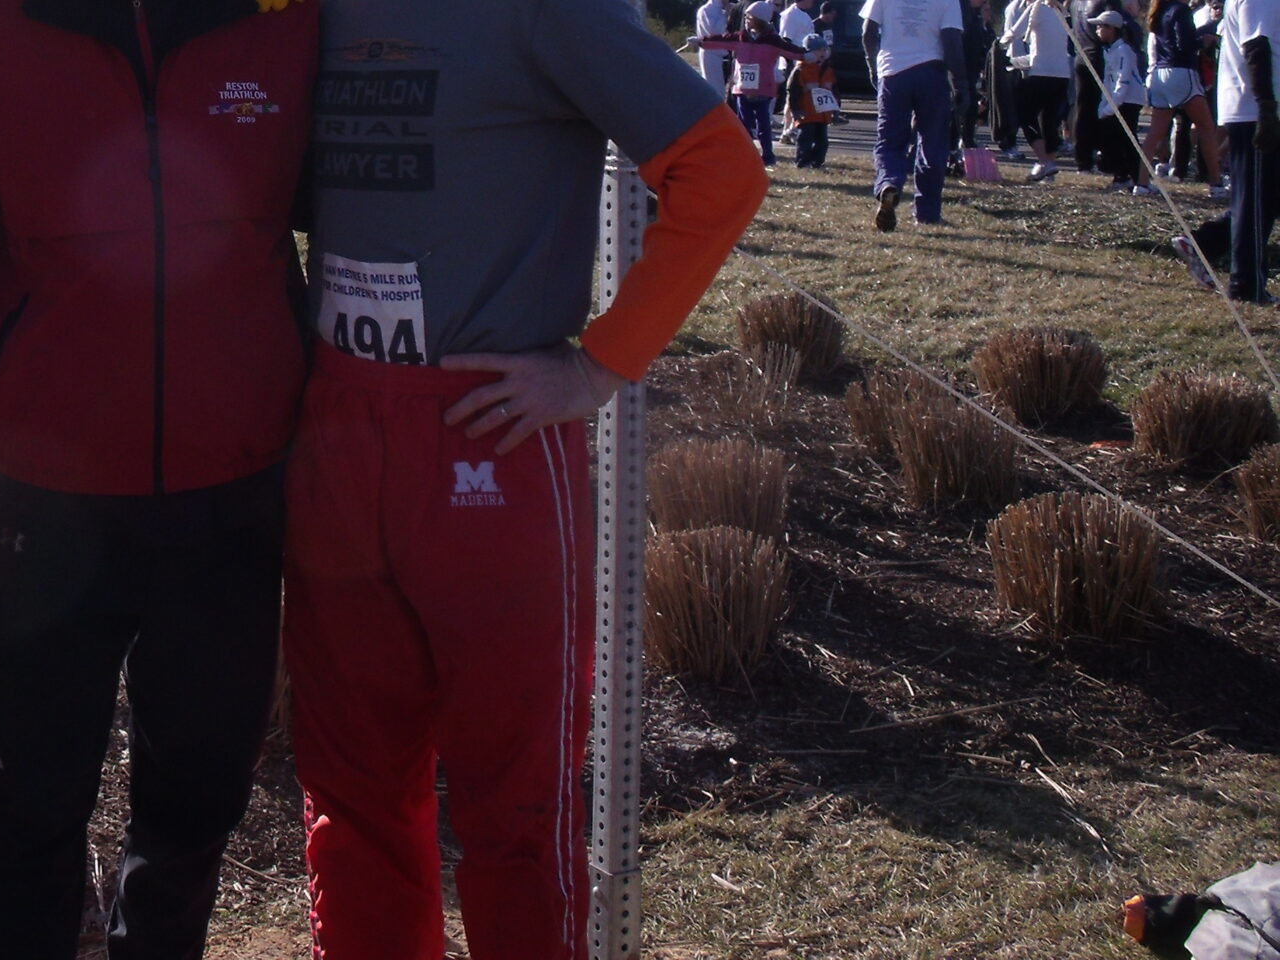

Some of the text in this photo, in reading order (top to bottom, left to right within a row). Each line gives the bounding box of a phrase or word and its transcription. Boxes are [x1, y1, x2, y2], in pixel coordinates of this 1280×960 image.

[219, 91, 268, 100] TRIATHLON
[225, 82, 259, 91] RESTON
[320, 79, 428, 105] RIATHLON
[816, 95, 834, 106] 971
[319, 120, 428, 137] RIAL
[316, 152, 418, 178] AWYER
[337, 268, 361, 283] METRE
[362, 274, 368, 284] 5
[370, 273, 396, 285] MILE
[398, 274, 420, 286] RUN
[332, 283, 379, 301] CHILDREN'S
[381, 290, 421, 301] HOSPIT
[333, 311, 424, 365] 494
[453, 461, 501, 493] M
[450, 495, 506, 507] MADEIRA
